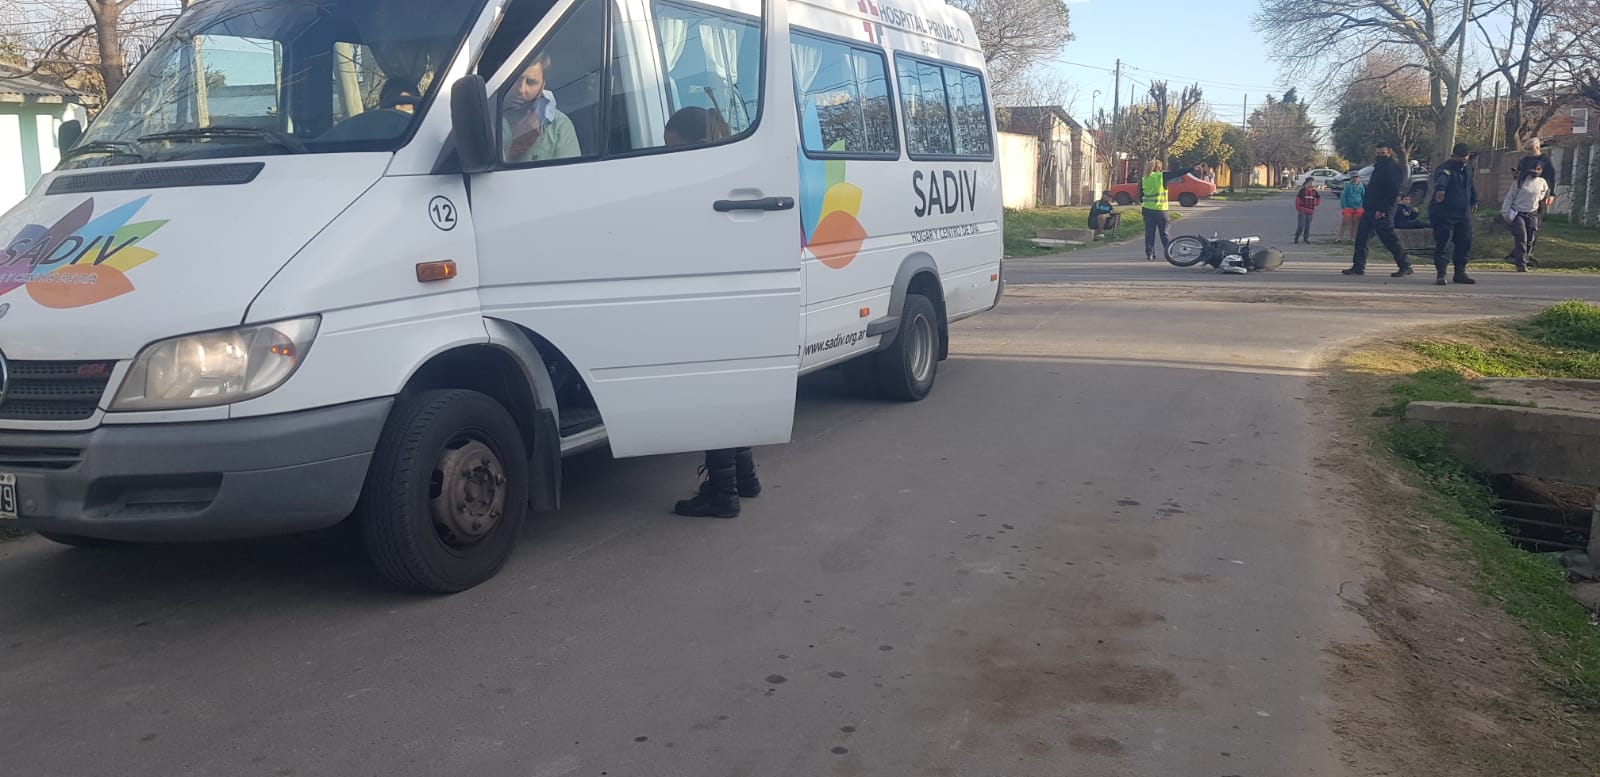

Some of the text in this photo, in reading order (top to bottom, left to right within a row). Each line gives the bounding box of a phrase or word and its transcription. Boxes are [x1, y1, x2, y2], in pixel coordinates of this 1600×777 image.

[878, 4, 965, 43] HOSPITAL PRIVADO
[912, 169, 977, 218] SADIV
[432, 204, 454, 222] 12
[911, 229, 932, 243] HOGAR
[940, 226, 961, 239] CENTRO
[0, 235, 139, 265] SADIV
[804, 329, 866, 355] www.sadiv.org.ar
